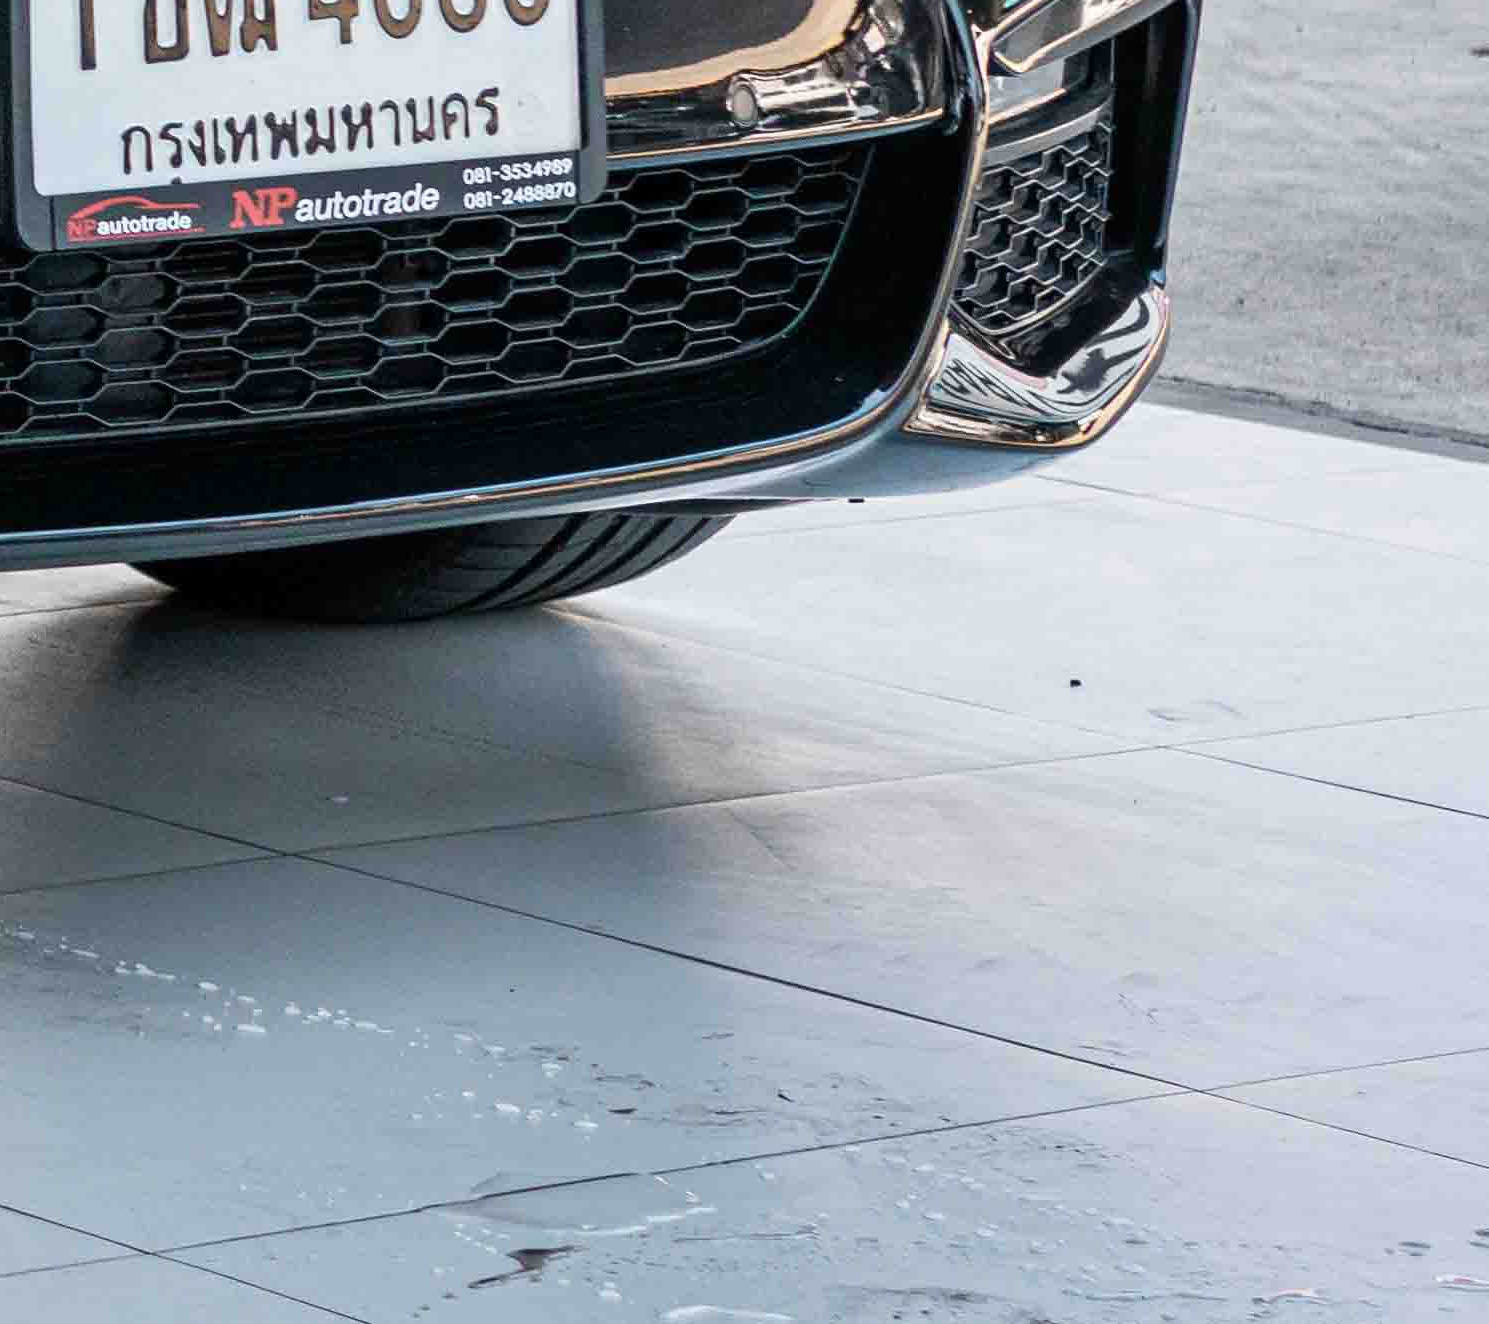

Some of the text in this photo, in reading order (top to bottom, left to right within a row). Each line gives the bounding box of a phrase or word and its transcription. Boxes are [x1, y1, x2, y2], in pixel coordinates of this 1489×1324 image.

[120, 85, 501, 186] กรุงเทพมหานคร
[462, 157, 574, 186] 081-3534989
